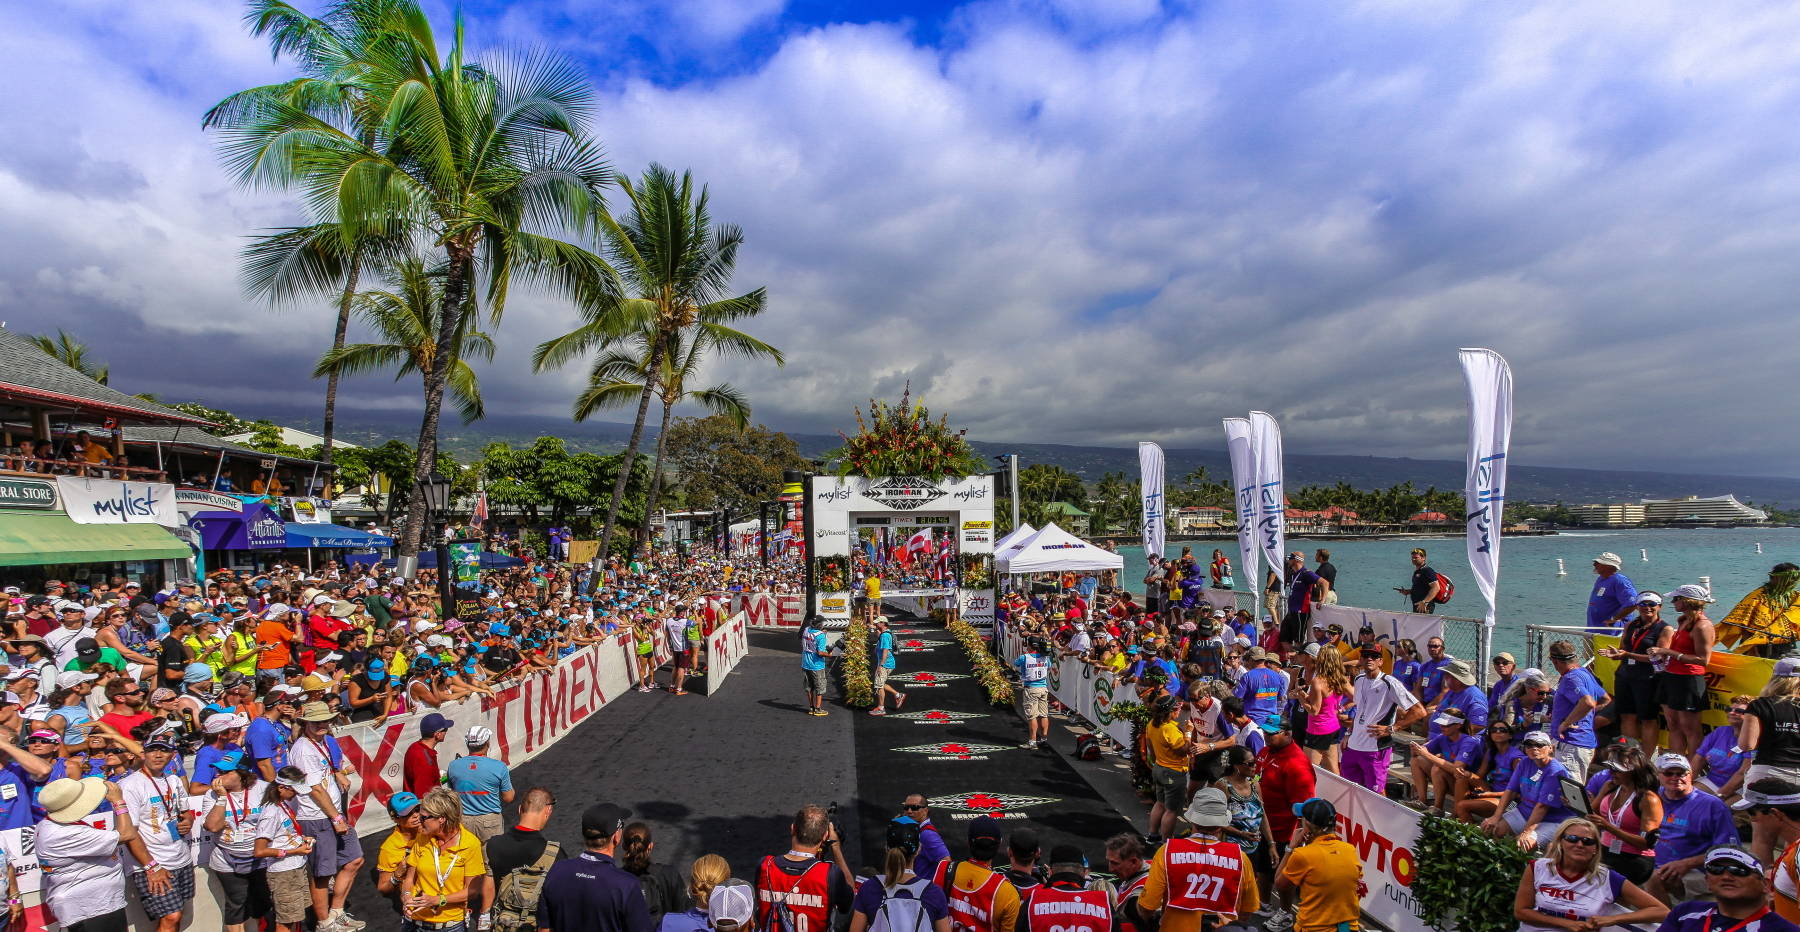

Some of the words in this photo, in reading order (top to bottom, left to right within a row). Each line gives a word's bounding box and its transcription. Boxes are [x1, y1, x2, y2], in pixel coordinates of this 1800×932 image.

[23, 487, 52, 500] STORE
[818, 485, 853, 504] mylist
[886, 486, 922, 497] IRONMAN
[953, 485, 988, 502] mylist
[94, 483, 159, 523] mylist
[209, 495, 238, 509] CUISINE
[250, 521, 286, 538] Atlantis
[965, 521, 991, 529] PowerBar
[1041, 541, 1086, 551] IRONMAN
[1034, 670, 1042, 679] 19
[480, 645, 607, 766] TIMEX
[1170, 849, 1239, 871] IRONMAN
[1183, 872, 1225, 902] 227
[1033, 897, 1107, 920] IRONMAN
